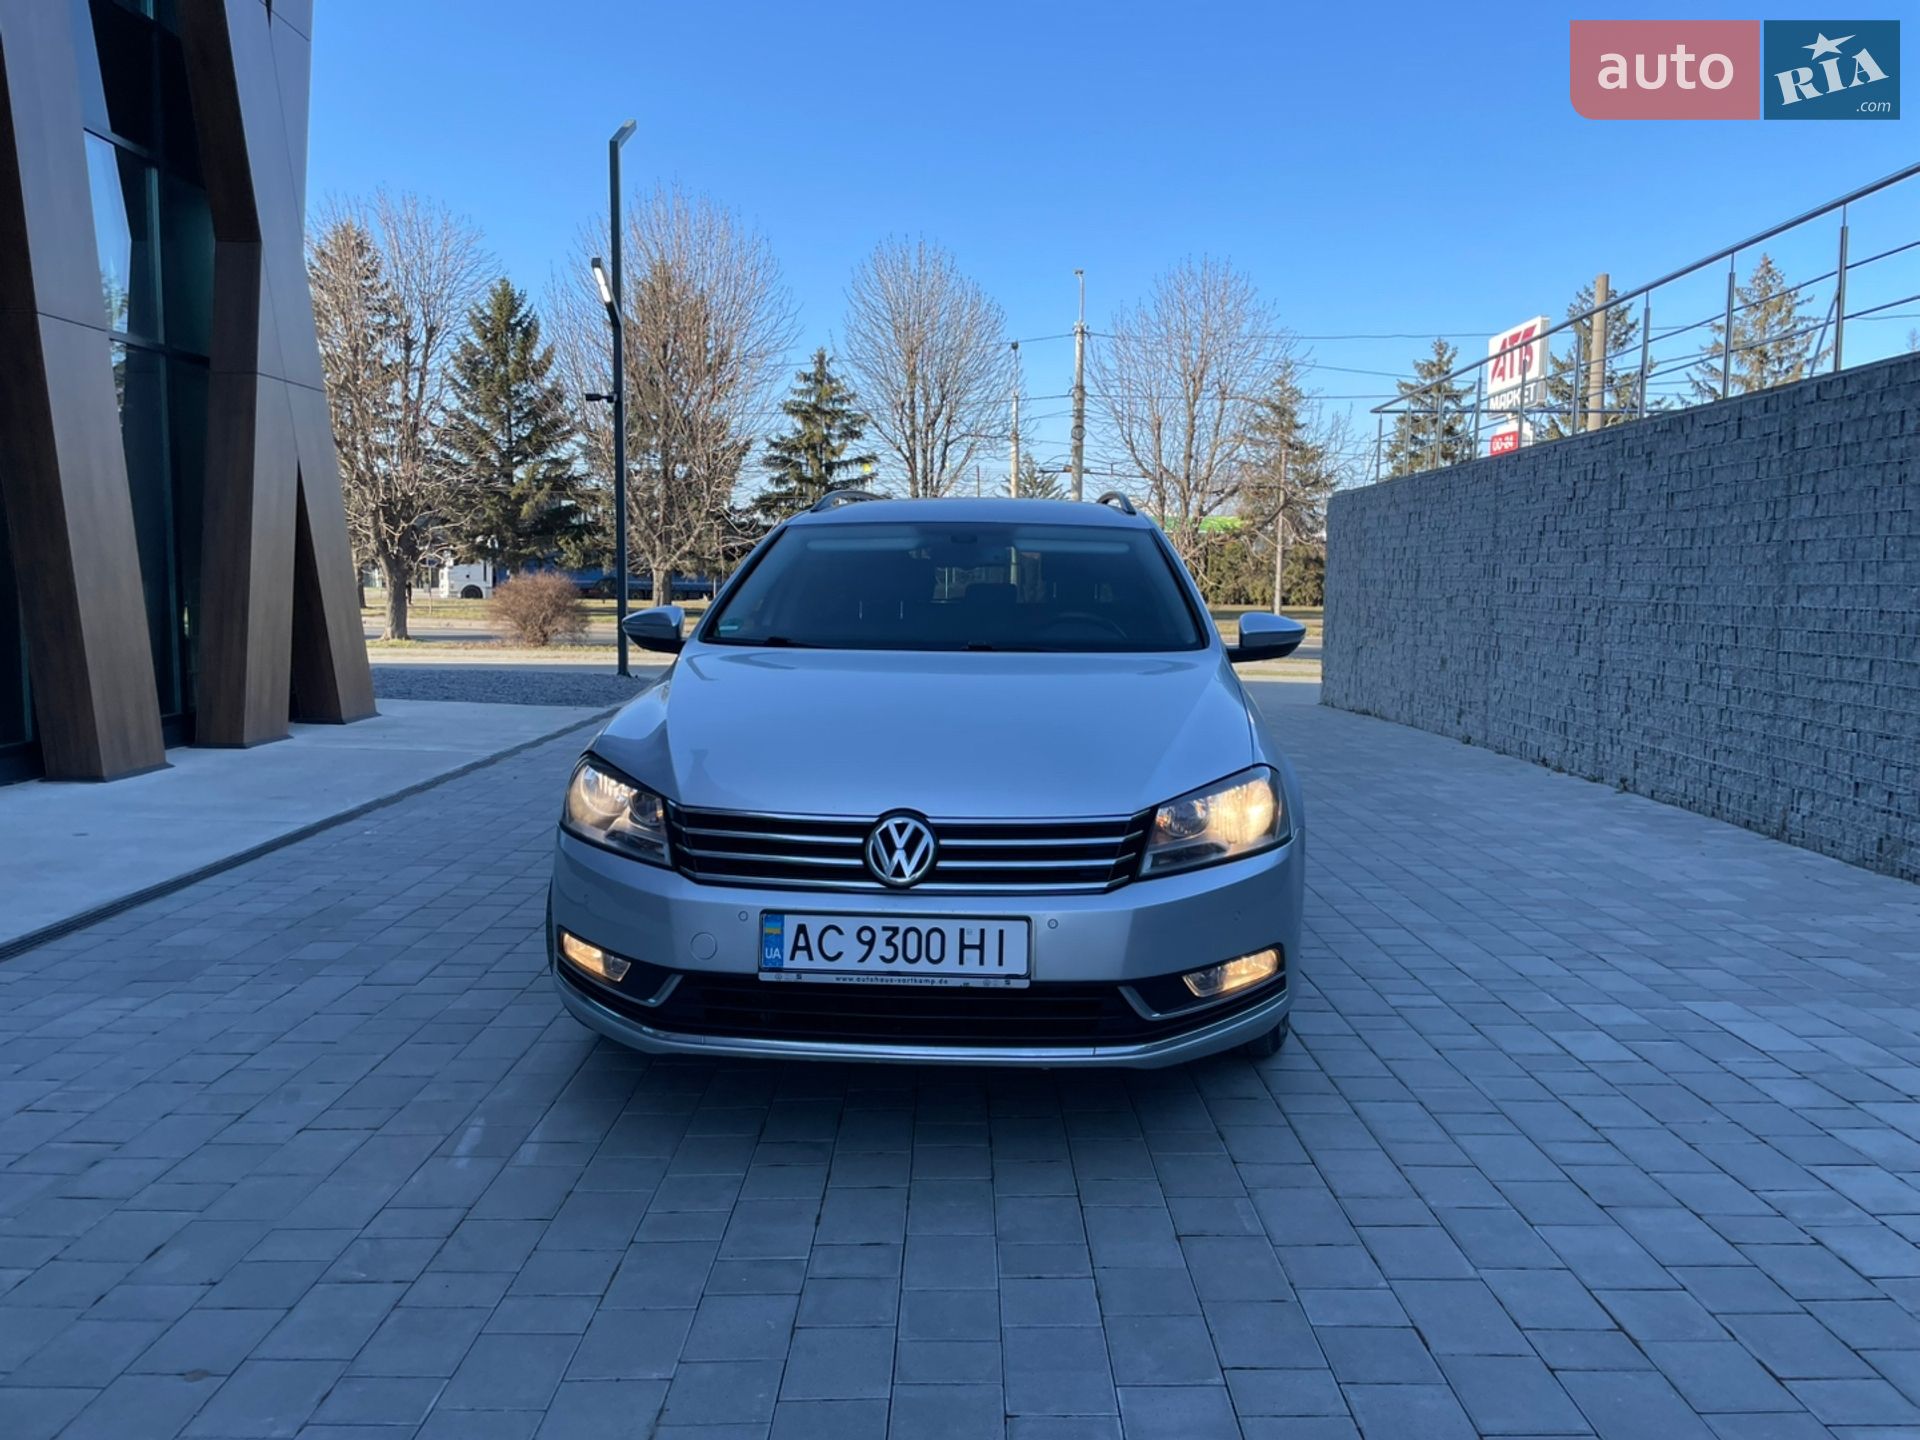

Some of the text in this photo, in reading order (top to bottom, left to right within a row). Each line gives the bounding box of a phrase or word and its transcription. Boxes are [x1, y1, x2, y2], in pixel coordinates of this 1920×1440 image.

[765, 946, 782, 960] UA
[789, 923, 1005, 967] AC 9300 HI
